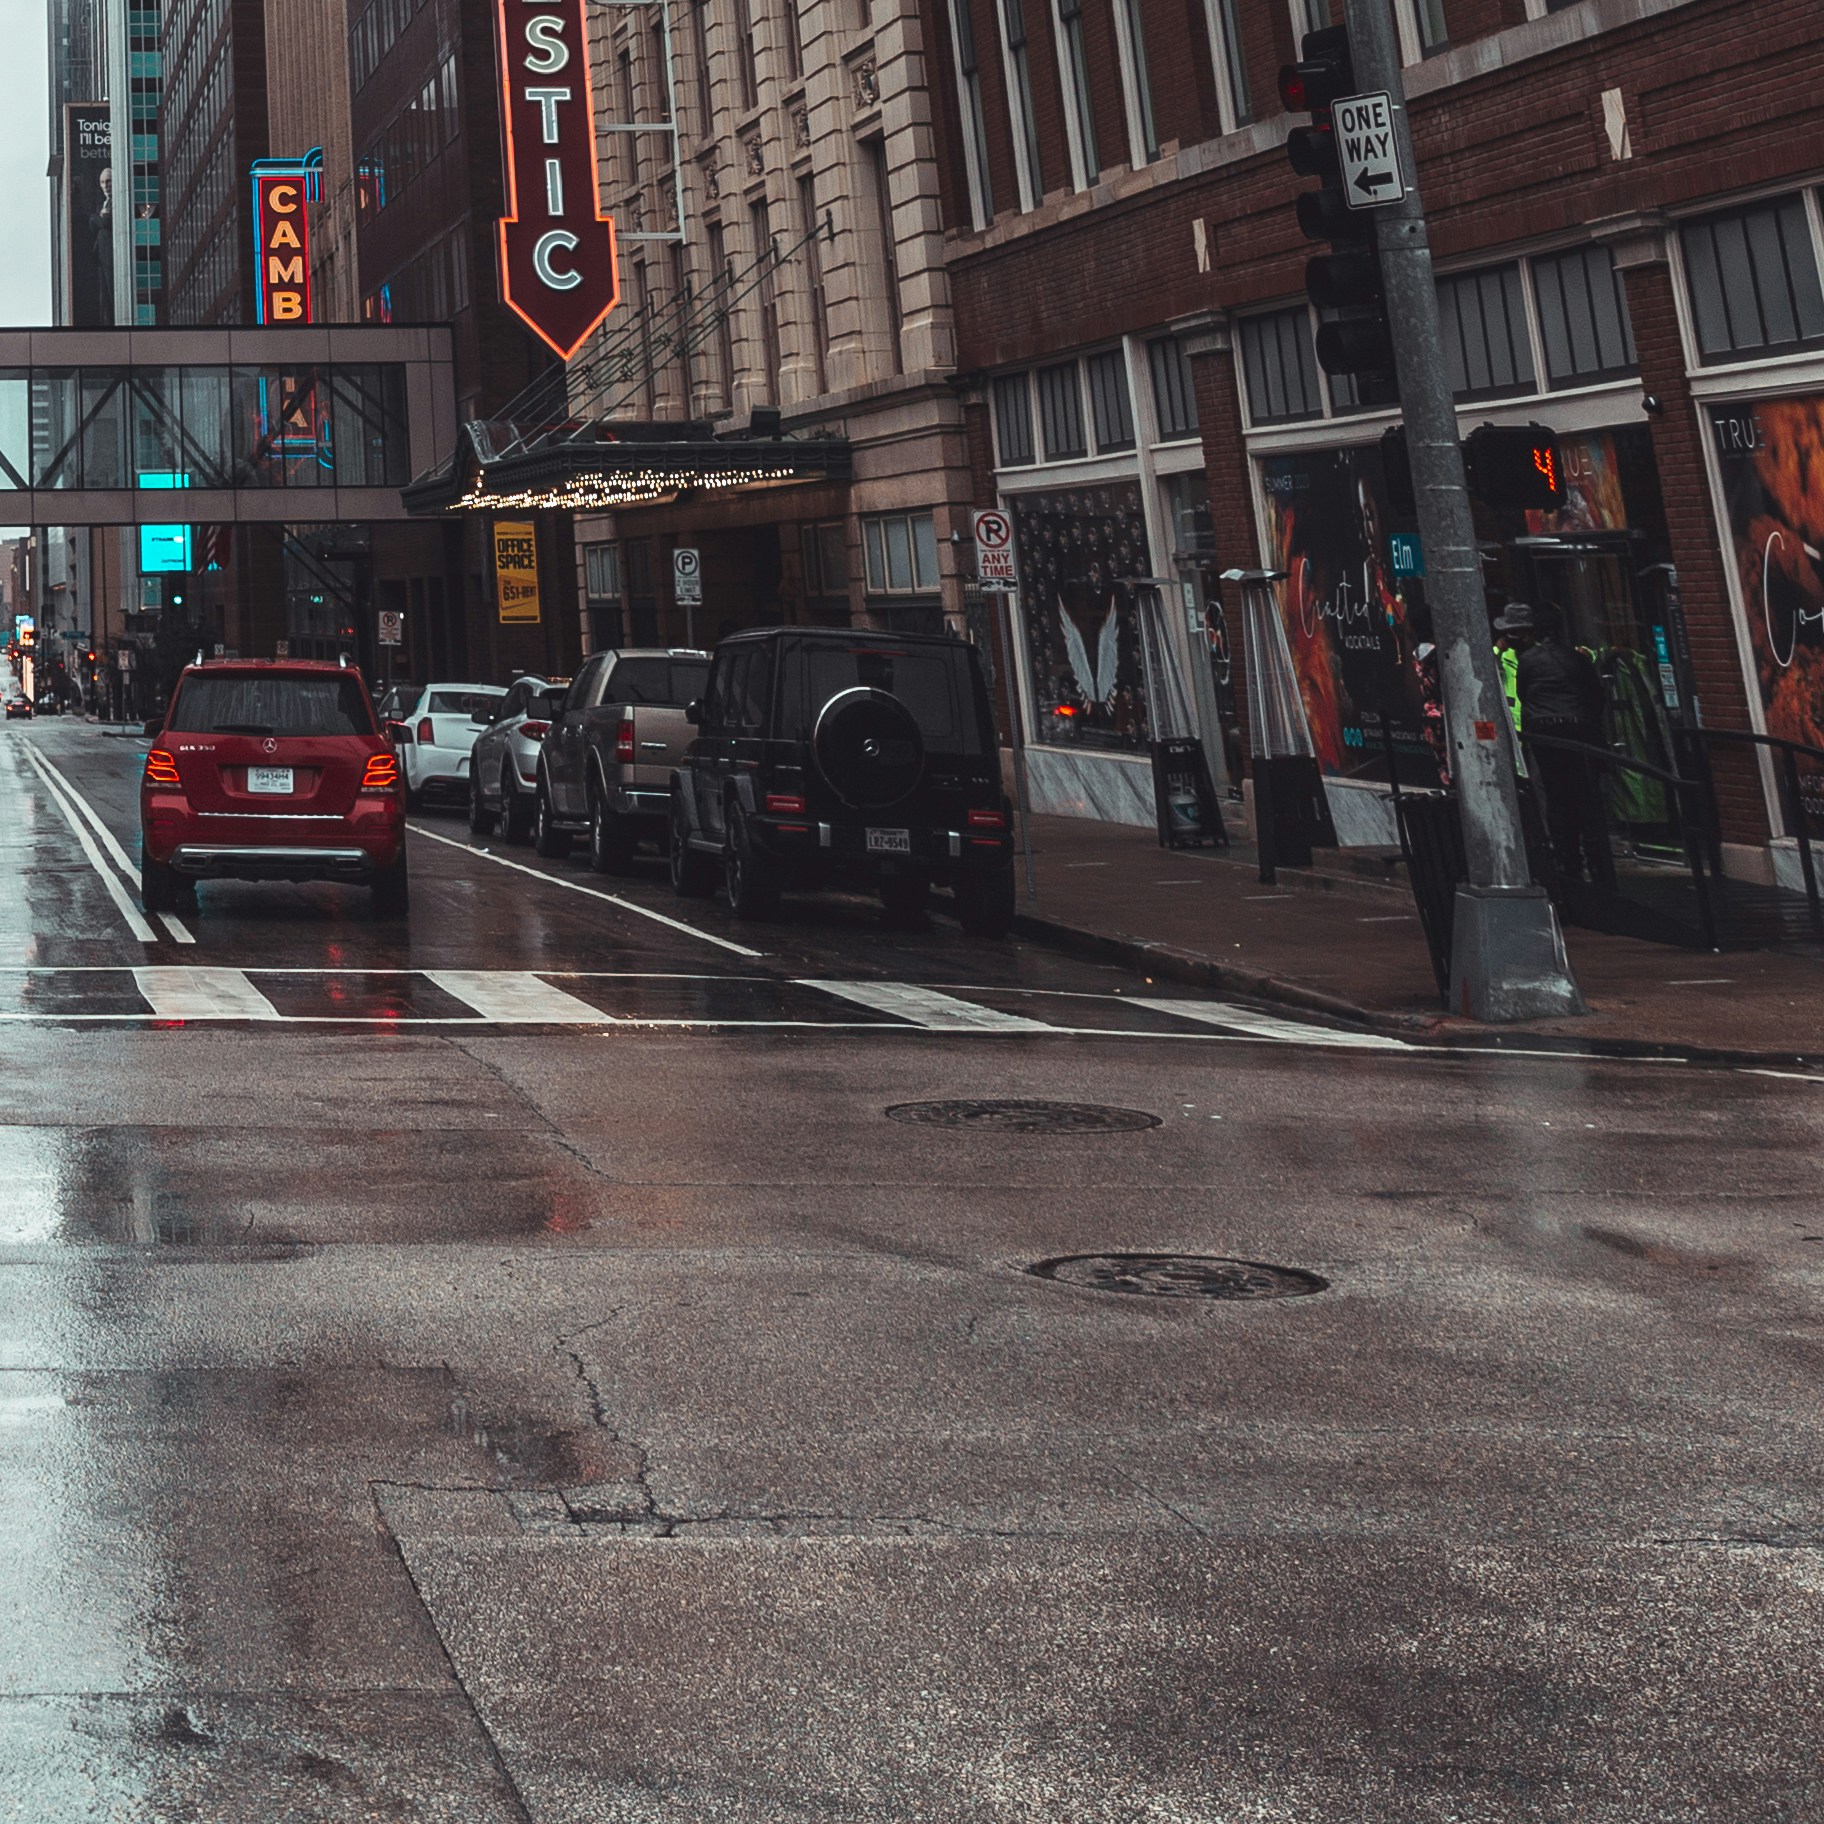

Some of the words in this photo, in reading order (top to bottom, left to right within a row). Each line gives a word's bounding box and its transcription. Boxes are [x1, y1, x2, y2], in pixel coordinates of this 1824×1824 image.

[1341, 102, 1387, 133] ONE
[1345, 132, 1389, 163] WAY
[1533, 448, 1556, 492] 4
[497, 538, 533, 553] OFFICE
[1392, 539, 1413, 570] Elm
[498, 553, 535, 569] SPACE
[982, 553, 1009, 565] ANY
[981, 565, 1013, 577] TIME
